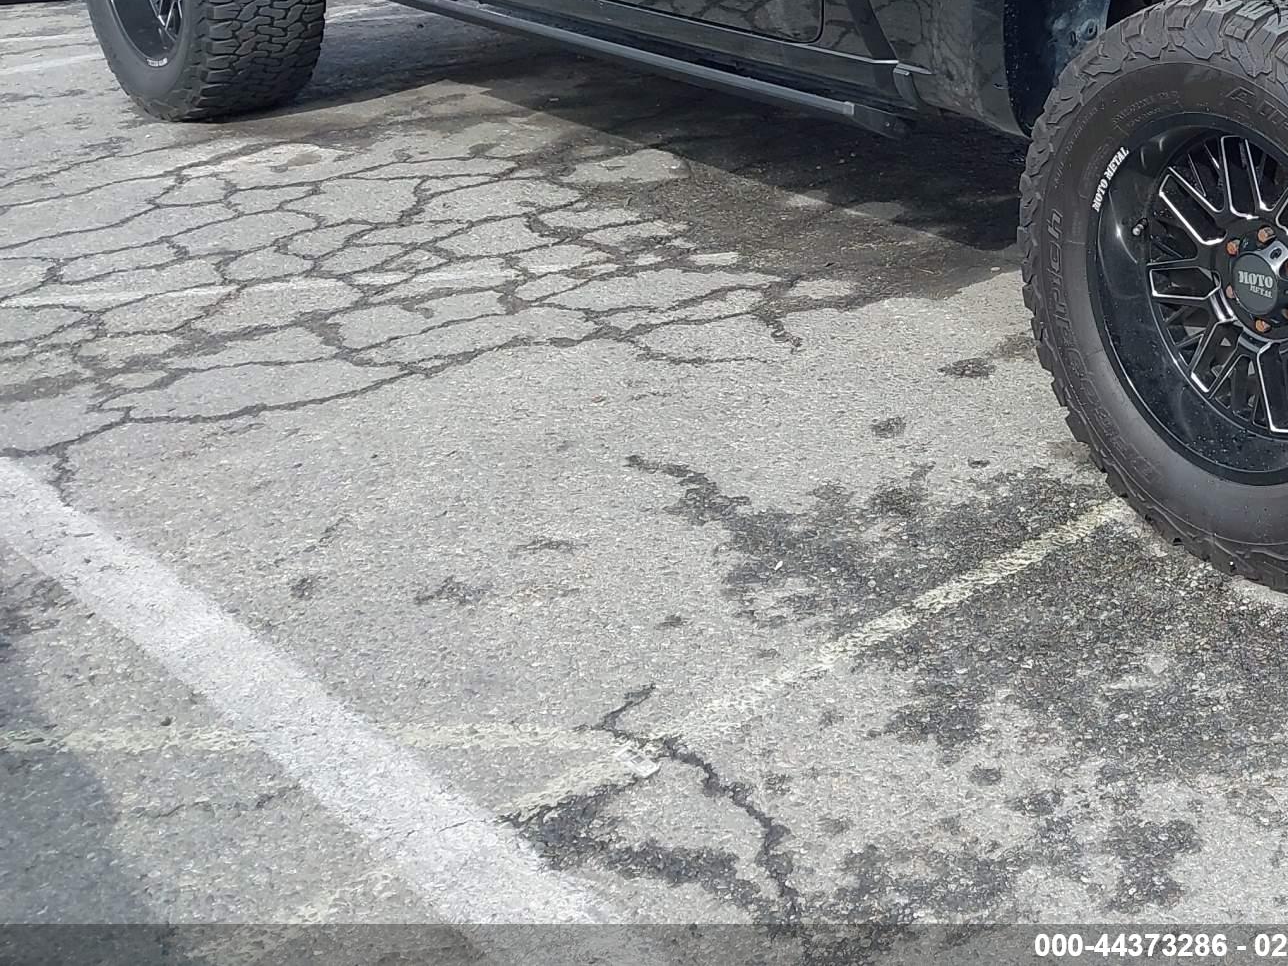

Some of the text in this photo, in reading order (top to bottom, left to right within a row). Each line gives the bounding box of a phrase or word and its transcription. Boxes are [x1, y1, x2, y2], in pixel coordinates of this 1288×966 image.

[1091, 178, 1109, 213] MOTO
[1103, 146, 1130, 181] METAL
[1238, 270, 1274, 289] MOTO
[1249, 284, 1273, 299] METAL
